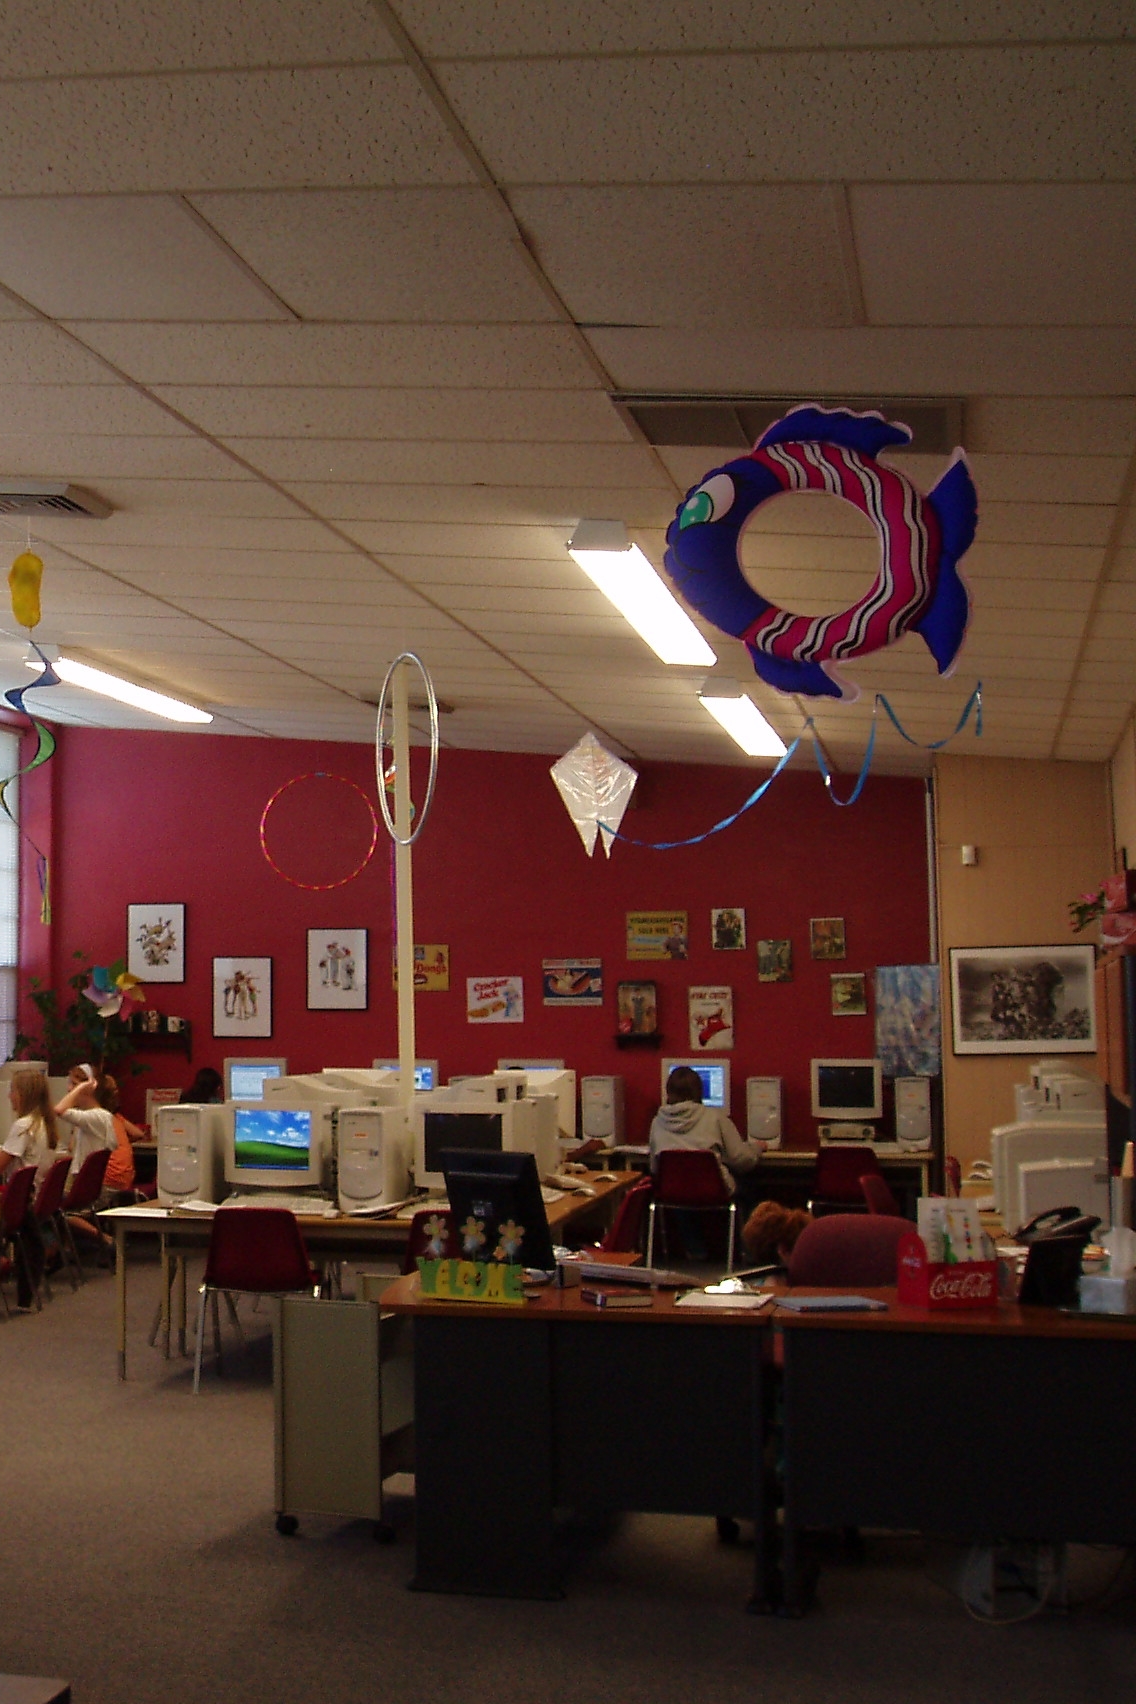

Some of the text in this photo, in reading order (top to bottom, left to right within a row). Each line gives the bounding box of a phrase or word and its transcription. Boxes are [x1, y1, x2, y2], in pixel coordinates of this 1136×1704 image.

[473, 979, 509, 992] Cracker
[477, 989, 499, 1001] Jack
[415, 1256, 524, 1299] WELCOME
